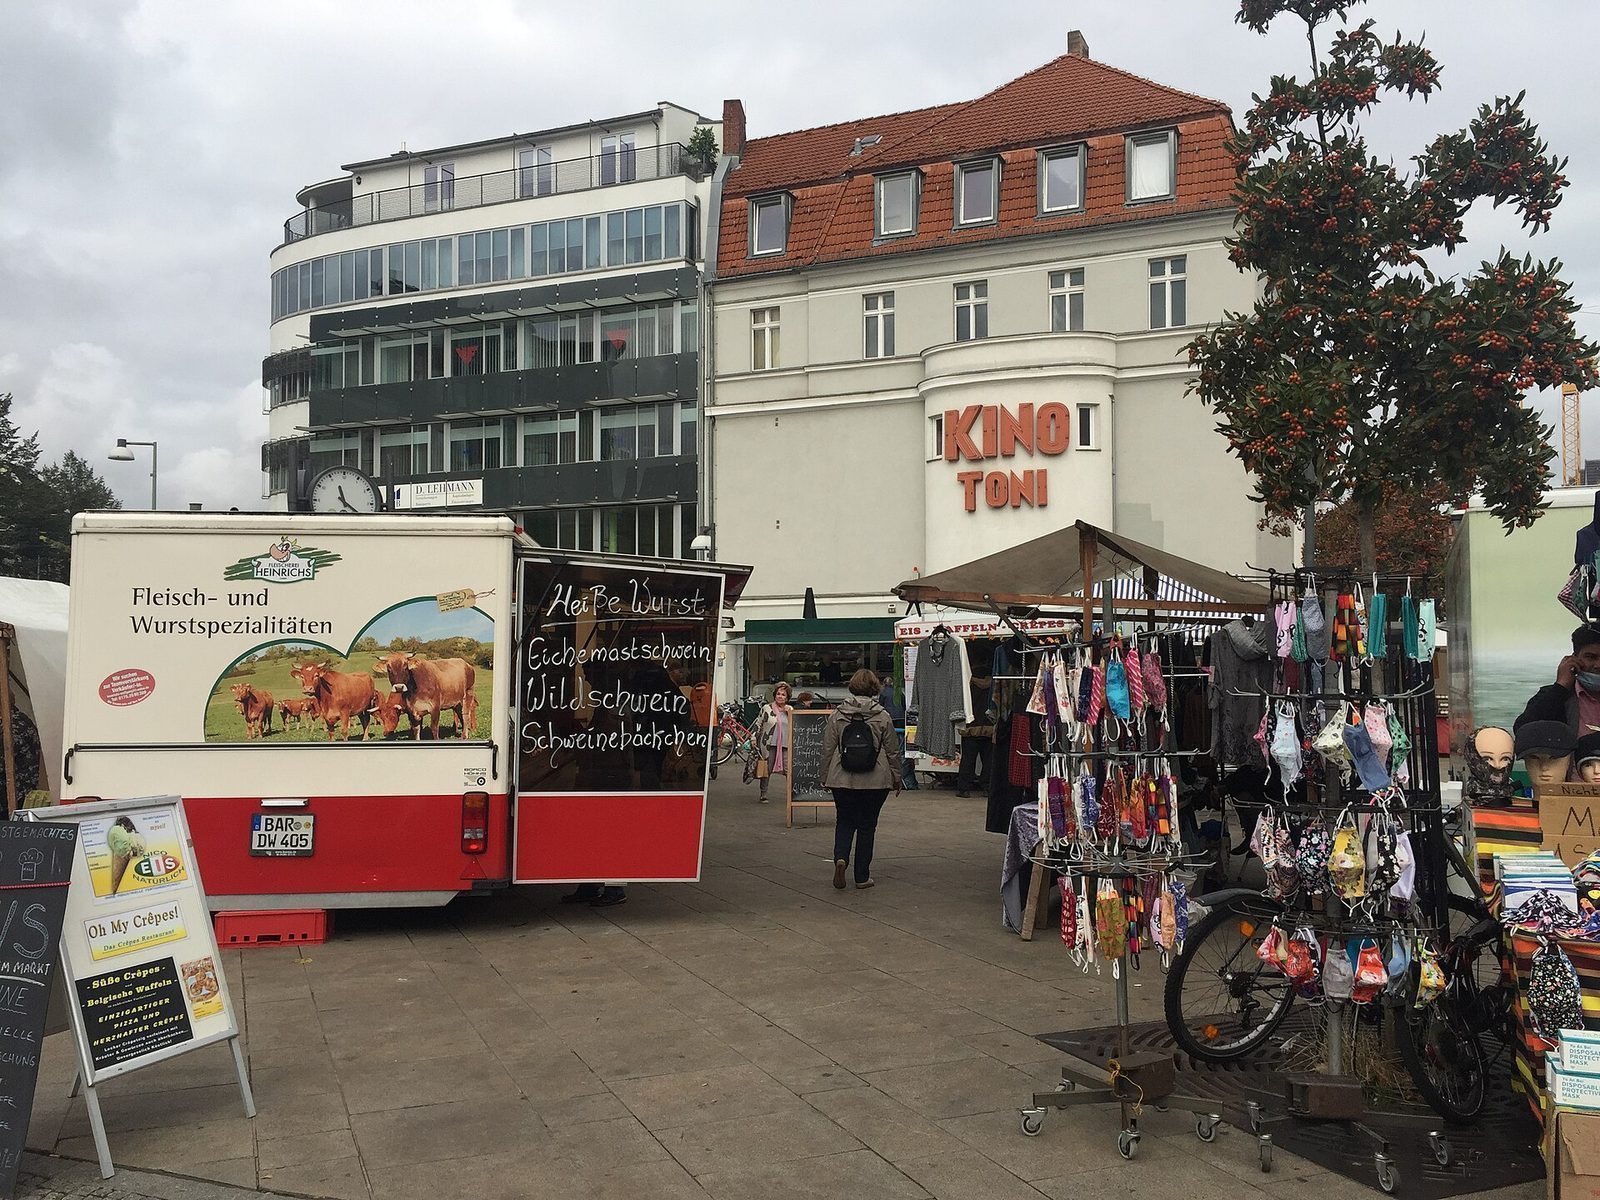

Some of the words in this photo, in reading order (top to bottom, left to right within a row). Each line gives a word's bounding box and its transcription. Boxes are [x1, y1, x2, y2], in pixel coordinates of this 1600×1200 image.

[944, 401, 1070, 461] KINO
[416, 485, 425, 494] D.
[427, 482, 475, 494] LEHMANN
[957, 469, 1048, 512] TONI
[255, 567, 311, 577] HEINRICHS
[132, 587, 218, 606] Fleisch-
[227, 588, 269, 606] und
[629, 577, 705, 617] Wurst
[130, 615, 332, 639] Wurstspezialitäten
[900, 627, 921, 636] EIS
[933, 623, 997, 633] AFFELN
[527, 632, 712, 671] Eichemastschwein
[526, 672, 689, 717] Wildschwein
[521, 720, 707, 769] Schweinebäckchen
[264, 817, 294, 832] BAR
[257, 833, 277, 848] DW
[280, 833, 309, 848] 405
[140, 857, 176, 874] EIS
[142, 850, 168, 859] NICO
[88, 924, 107, 939] Oh
[111, 919, 129, 934] My
[133, 905, 179, 928] Crêpes!
[117, 938, 140, 948] Crêpes
[141, 929, 175, 942] Restaurant
[13, 961, 51, 976] MARKT
[91, 976, 121, 989] Süße
[123, 965, 160, 981] Crêpes
[86, 990, 133, 1008] Belgische
[135, 979, 173, 994] Waffeln
[98, 997, 171, 1023] EINZIGARTIGER
[113, 1017, 139, 1030] PIZZA
[142, 1011, 161, 1021] UND
[93, 1024, 150, 1047] HERZHAFTER
[153, 1013, 185, 1028] CRÊPES
